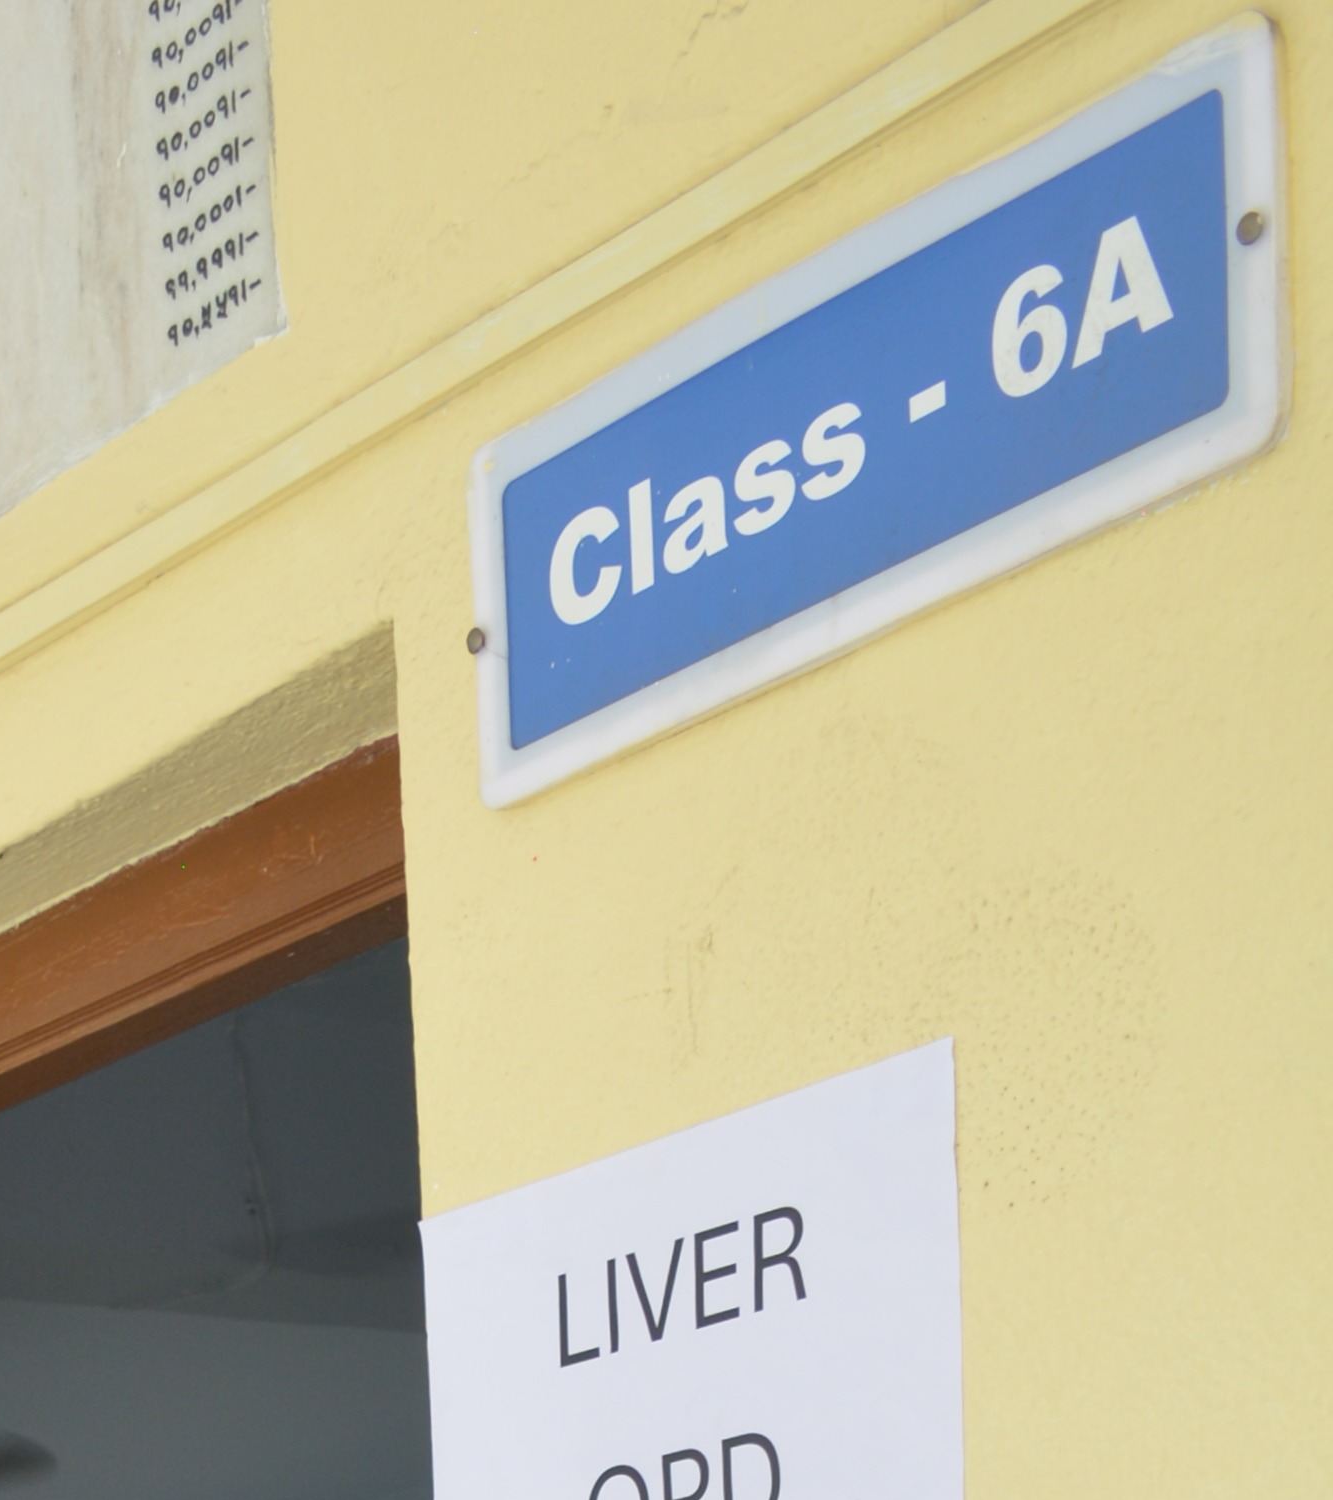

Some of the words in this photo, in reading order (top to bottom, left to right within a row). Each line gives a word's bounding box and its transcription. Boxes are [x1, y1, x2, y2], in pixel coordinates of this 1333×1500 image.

[548, 398, 868, 627] Class
[993, 218, 1171, 396] 6A
[559, 1207, 805, 1367] LIVER
